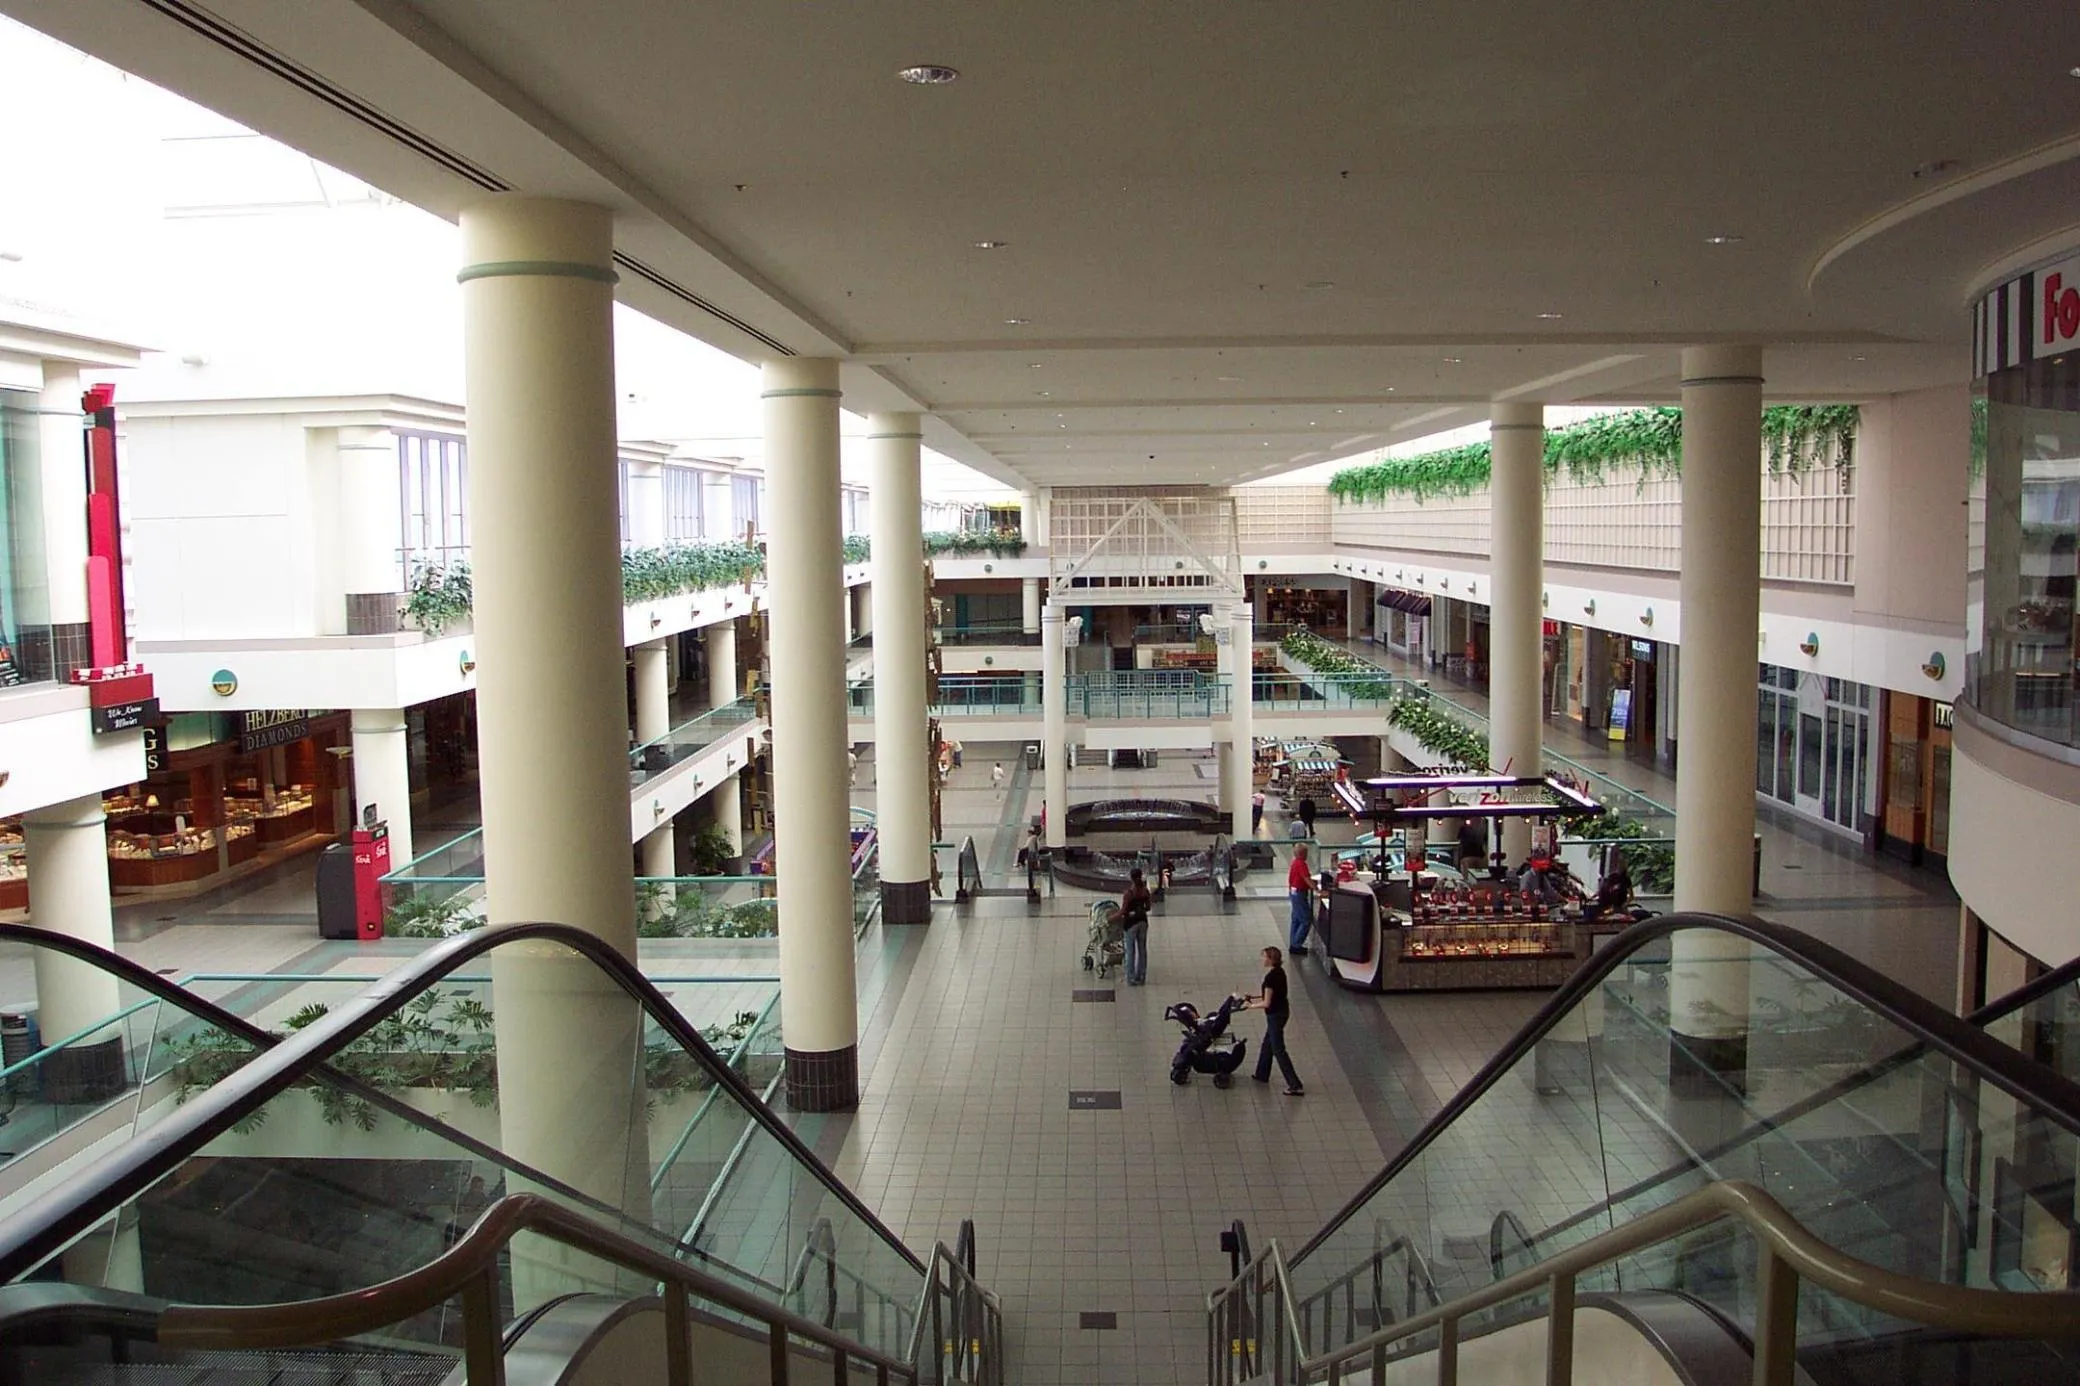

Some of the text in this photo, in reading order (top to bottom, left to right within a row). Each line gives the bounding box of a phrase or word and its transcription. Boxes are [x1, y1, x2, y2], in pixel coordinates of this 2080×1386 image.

[247, 724, 307, 750] DIAMONDS
[1448, 789, 1554, 806] verizon wireless
